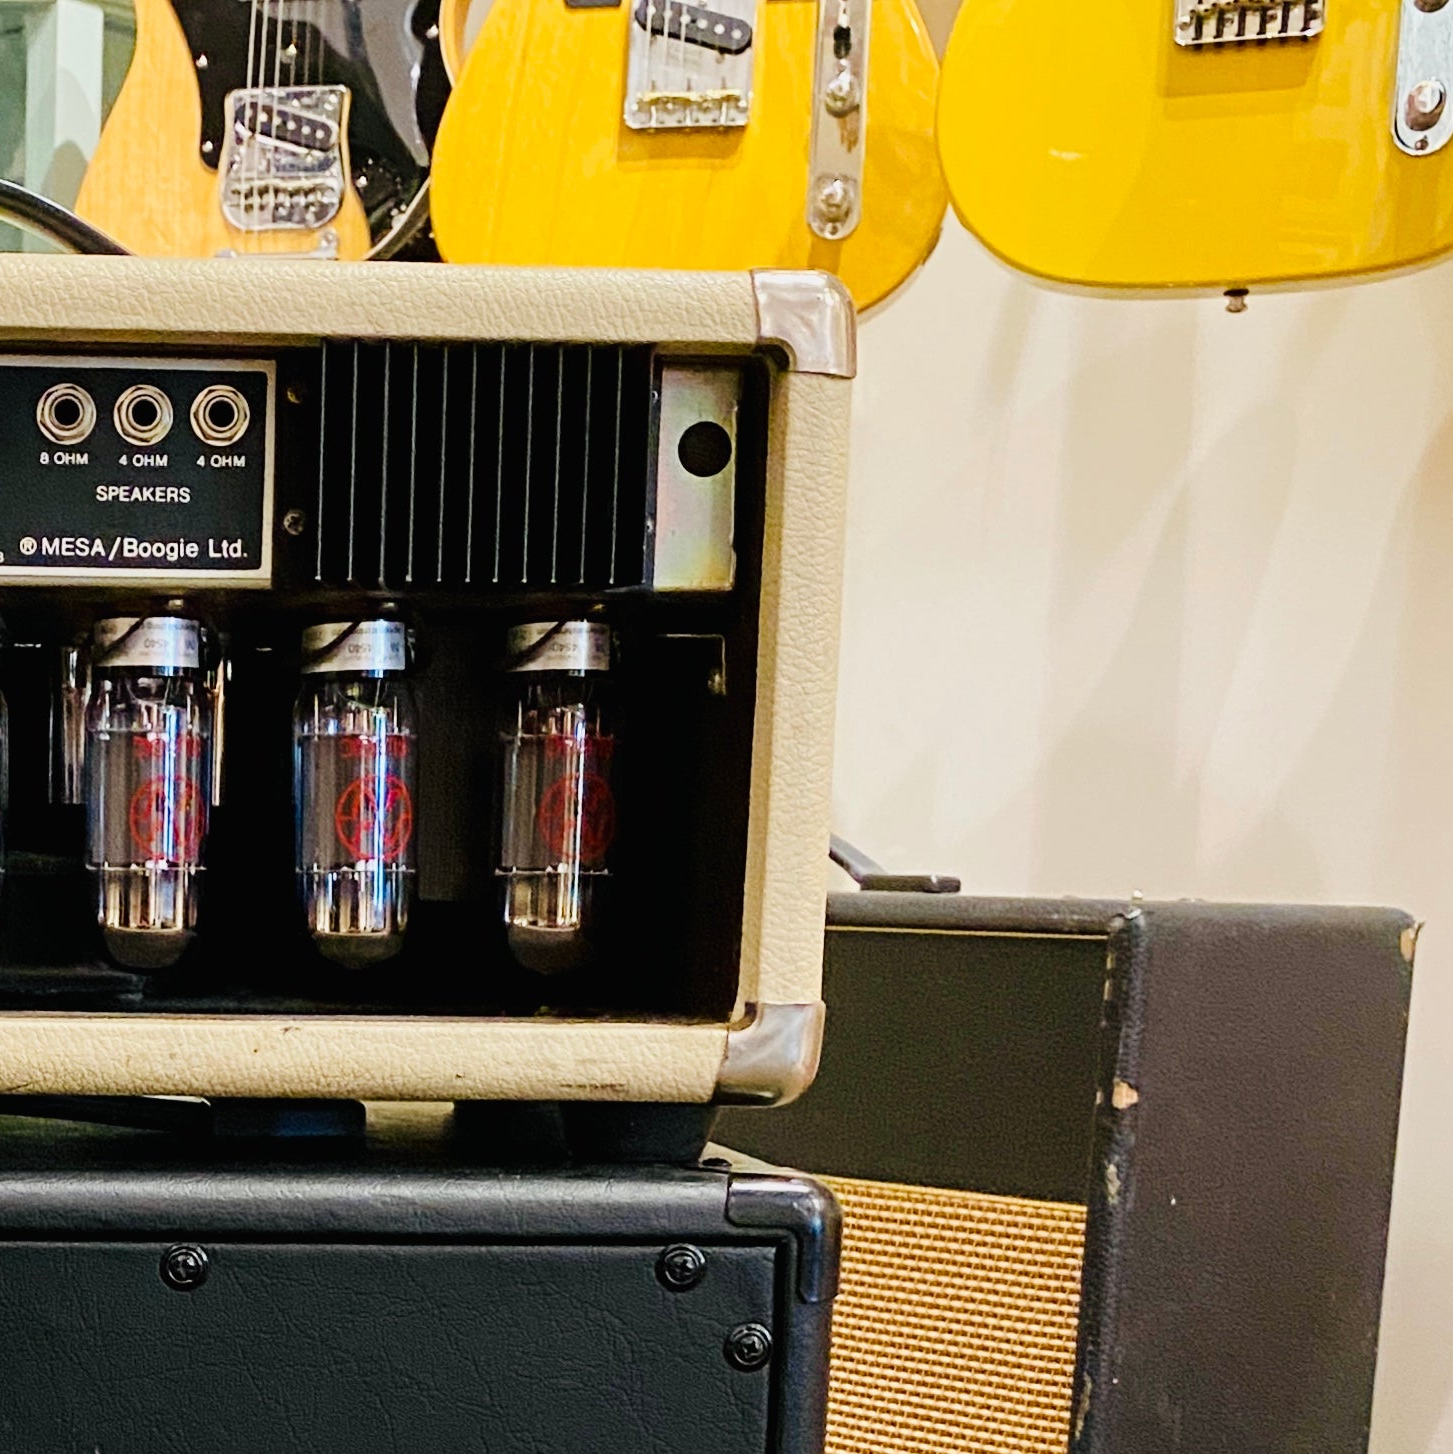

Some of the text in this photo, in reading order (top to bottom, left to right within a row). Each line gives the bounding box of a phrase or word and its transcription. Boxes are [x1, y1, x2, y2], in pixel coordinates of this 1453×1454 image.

[39, 452, 89, 465] 8 OHM
[118, 454, 168, 467] 4 OHM
[196, 455, 246, 468] 4 OHM
[96, 485, 191, 503] SPEAKERS
[208, 539, 248, 558] Ltd.
